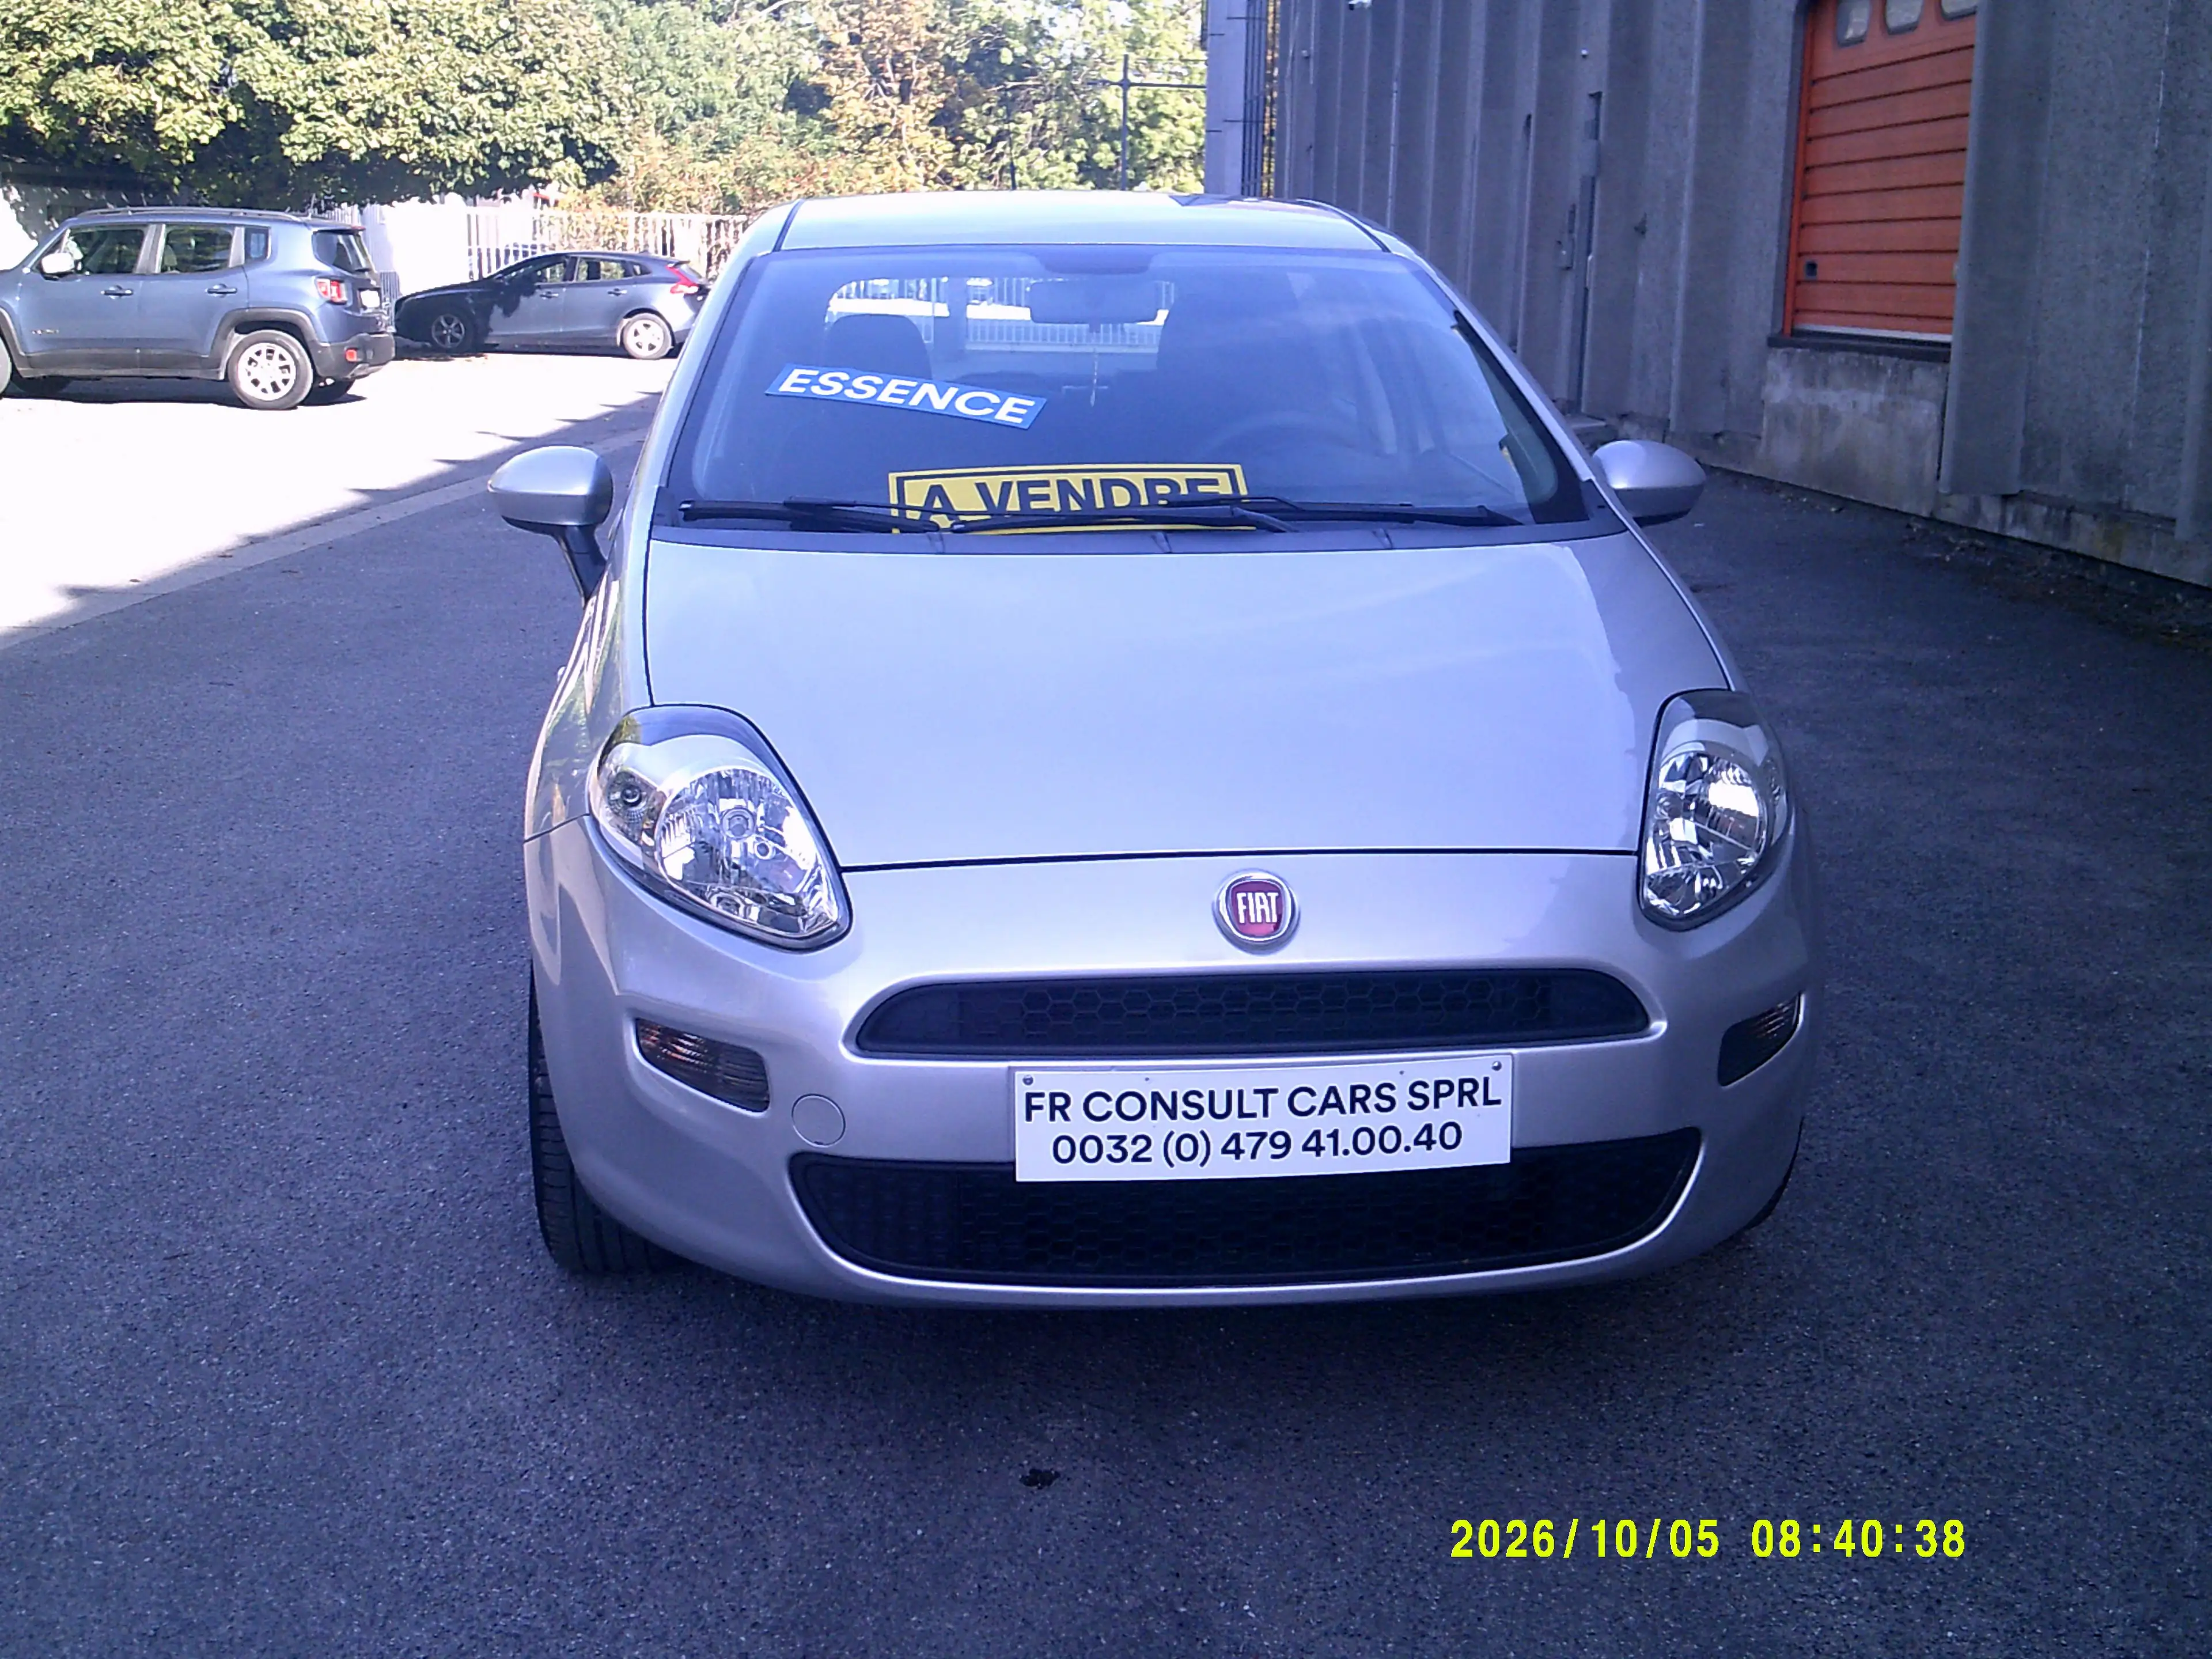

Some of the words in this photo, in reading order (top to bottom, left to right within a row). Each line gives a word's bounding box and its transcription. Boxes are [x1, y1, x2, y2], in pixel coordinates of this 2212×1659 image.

[778, 369, 1035, 423] ESSENCE
[920, 484, 961, 521] A
[1236, 892, 1278, 923] FIAT
[1025, 1091, 1071, 1122] FR
[1082, 1086, 1279, 1122] CONSULT
[1287, 1082, 1397, 1117] CARS
[1407, 1076, 1502, 1111] SPRL
[1052, 1134, 1153, 1164] 0032
[1163, 1130, 1211, 1168] (0)
[1221, 1130, 1292, 1161] 479
[1301, 1121, 1463, 1158] 41.00.40
